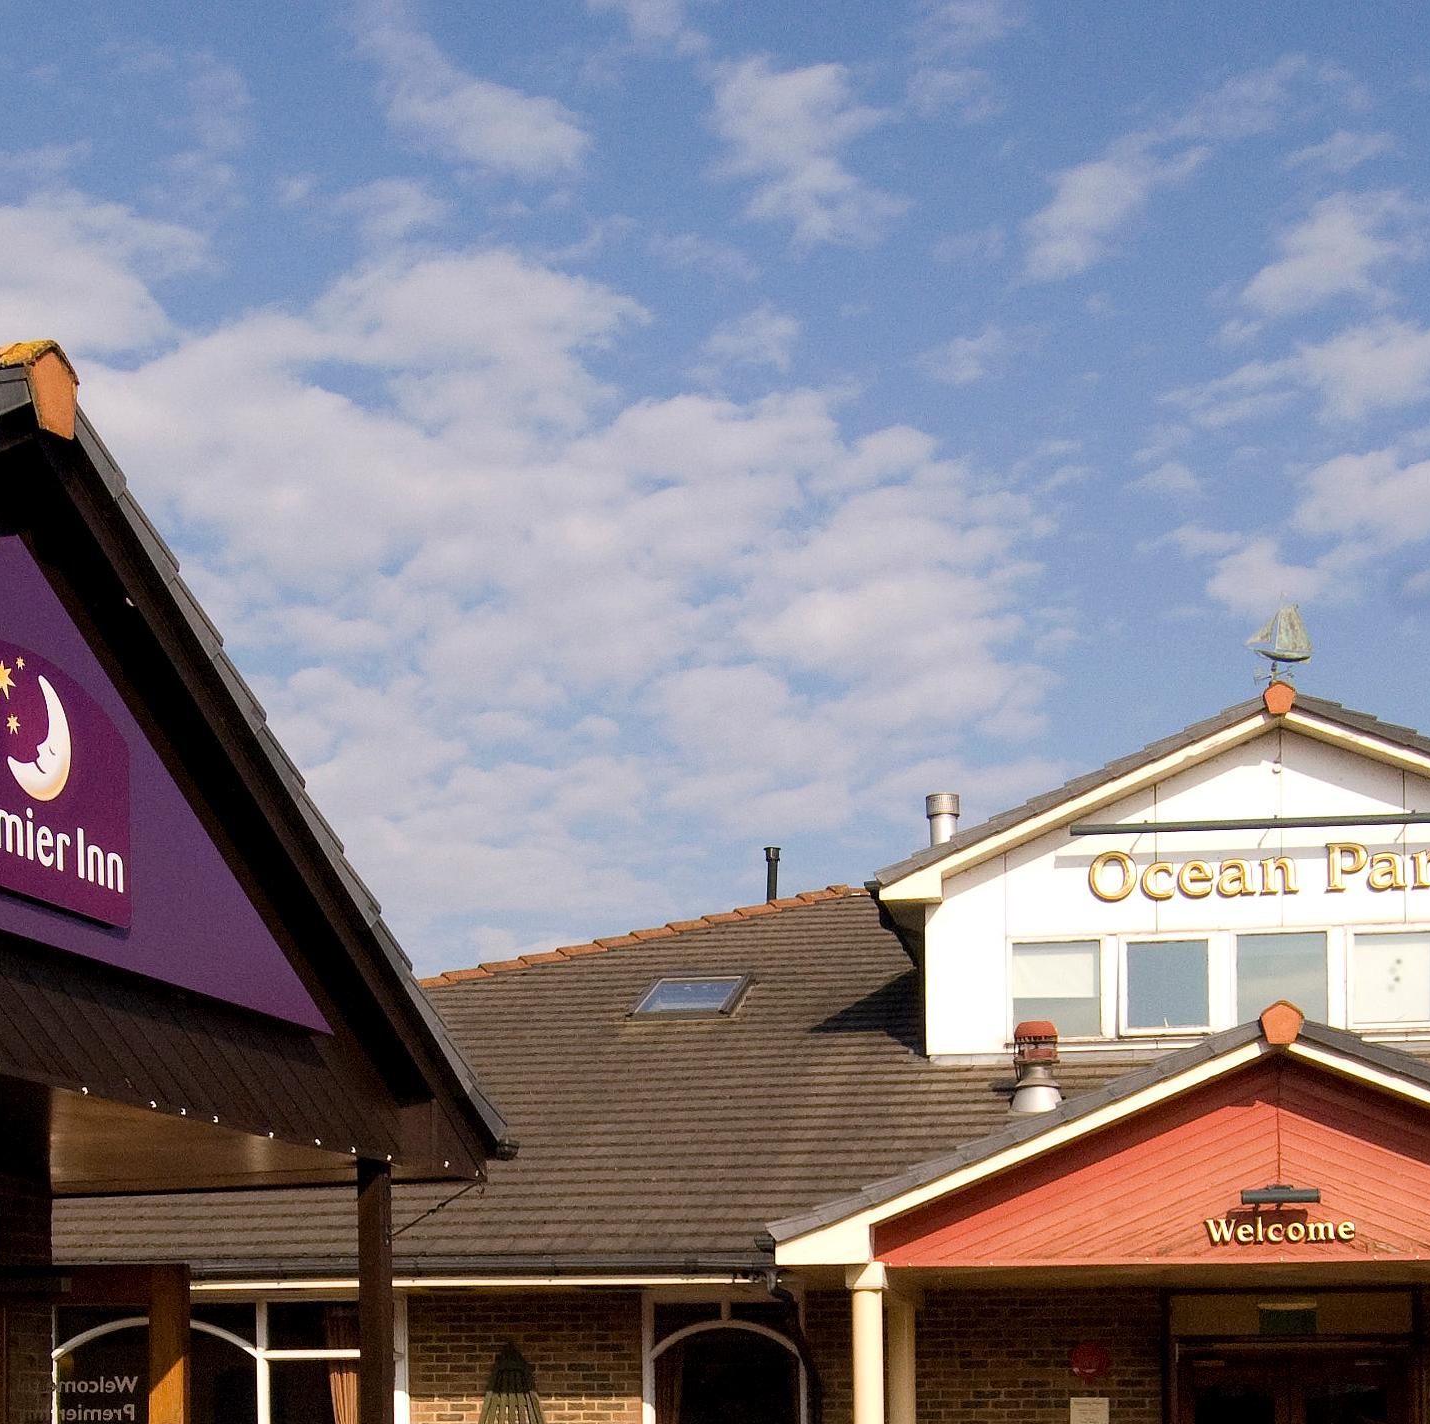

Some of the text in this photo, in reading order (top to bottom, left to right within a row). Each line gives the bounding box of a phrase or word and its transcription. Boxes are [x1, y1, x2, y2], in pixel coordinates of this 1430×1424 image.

[77, 828, 124, 893] Inn
[1089, 851, 1299, 902] Ocean
[1204, 1216, 1355, 1246] Welcome
